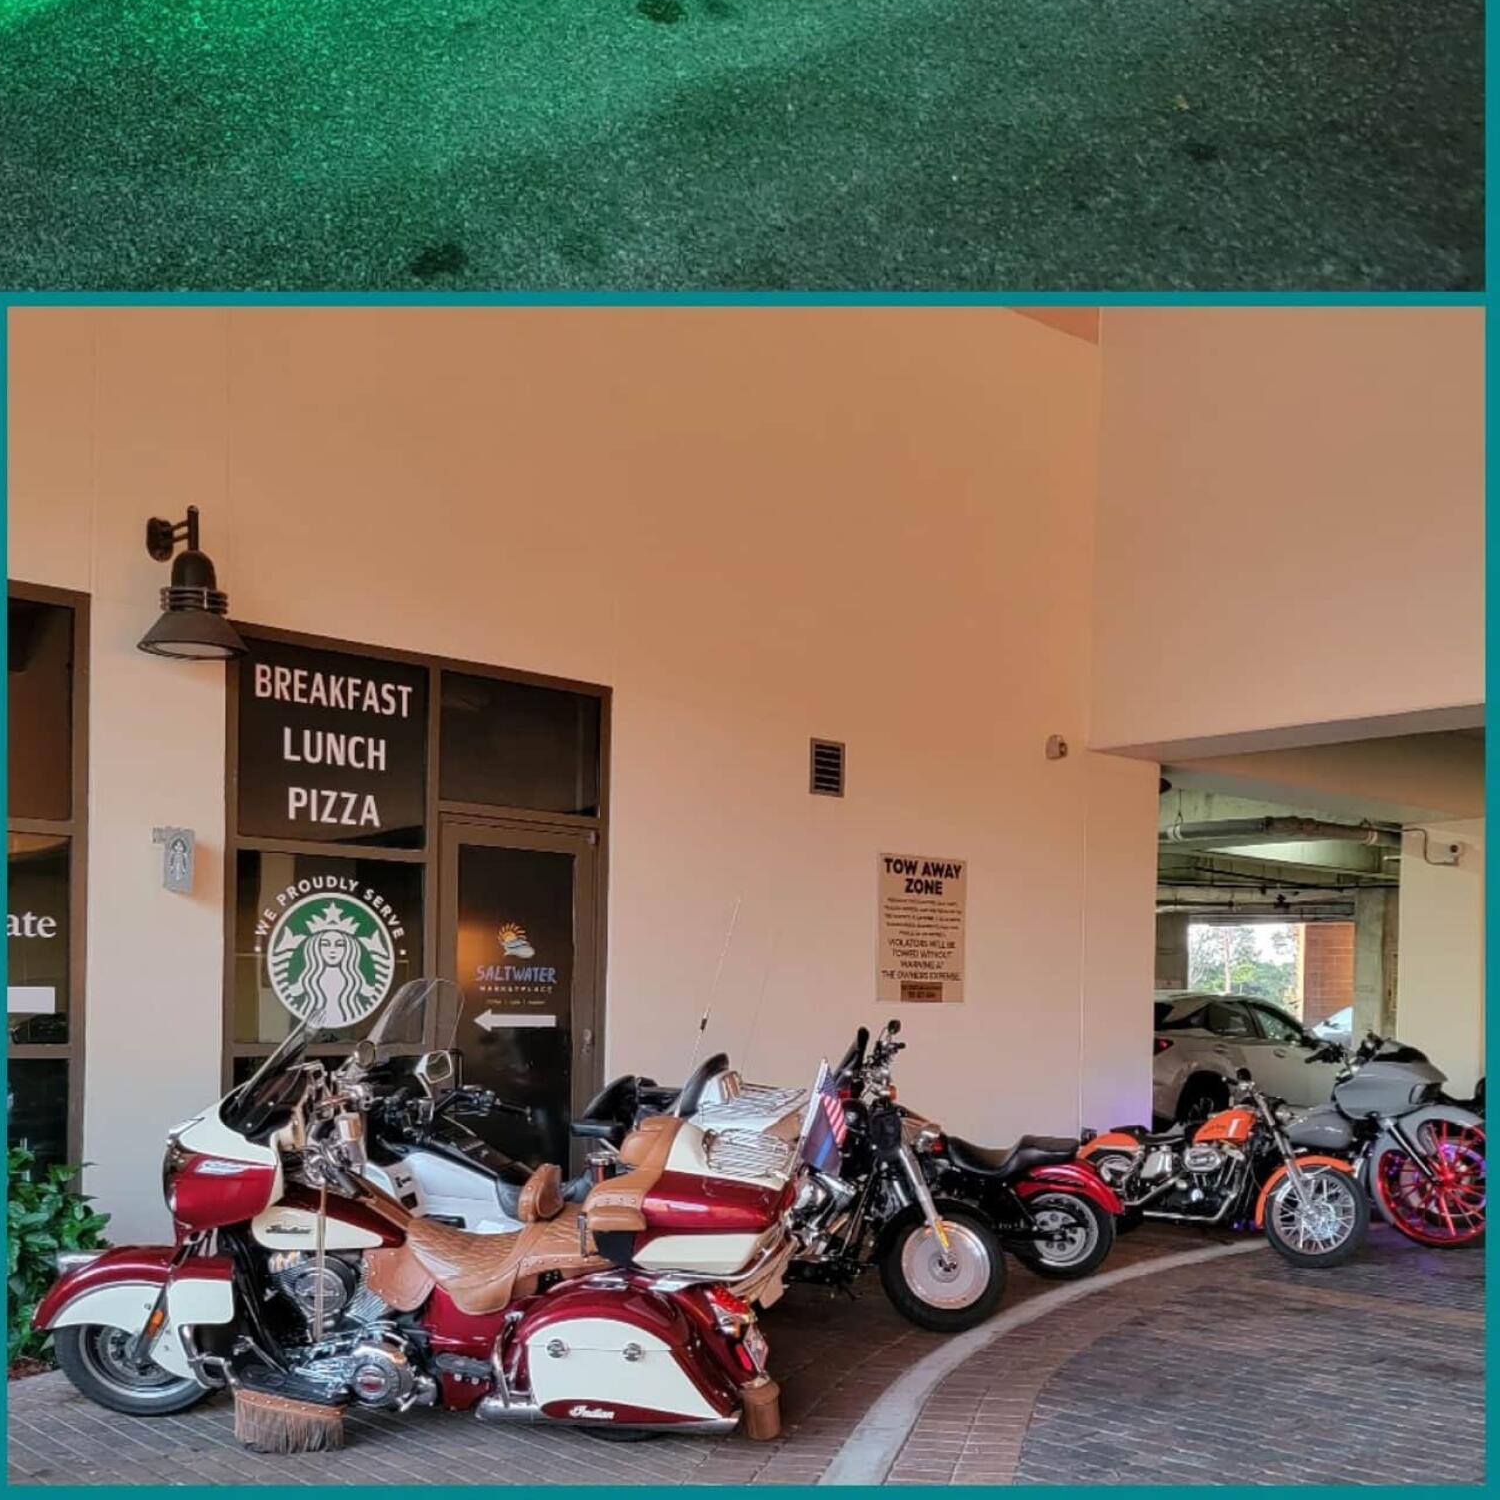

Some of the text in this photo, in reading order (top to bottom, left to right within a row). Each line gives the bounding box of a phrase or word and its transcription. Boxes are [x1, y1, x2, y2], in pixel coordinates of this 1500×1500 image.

[255, 663, 413, 719] BREAKFAST
[283, 726, 386, 772] LUNCH
[288, 786, 381, 828] PIZZA
[884, 857, 962, 879] TOW AWAY
[904, 878, 943, 895] ZONE
[255, 875, 405, 940] WE PROUDLY SERVE
[475, 964, 558, 985] SALTWATER
[568, 1403, 615, 1420] Indian
